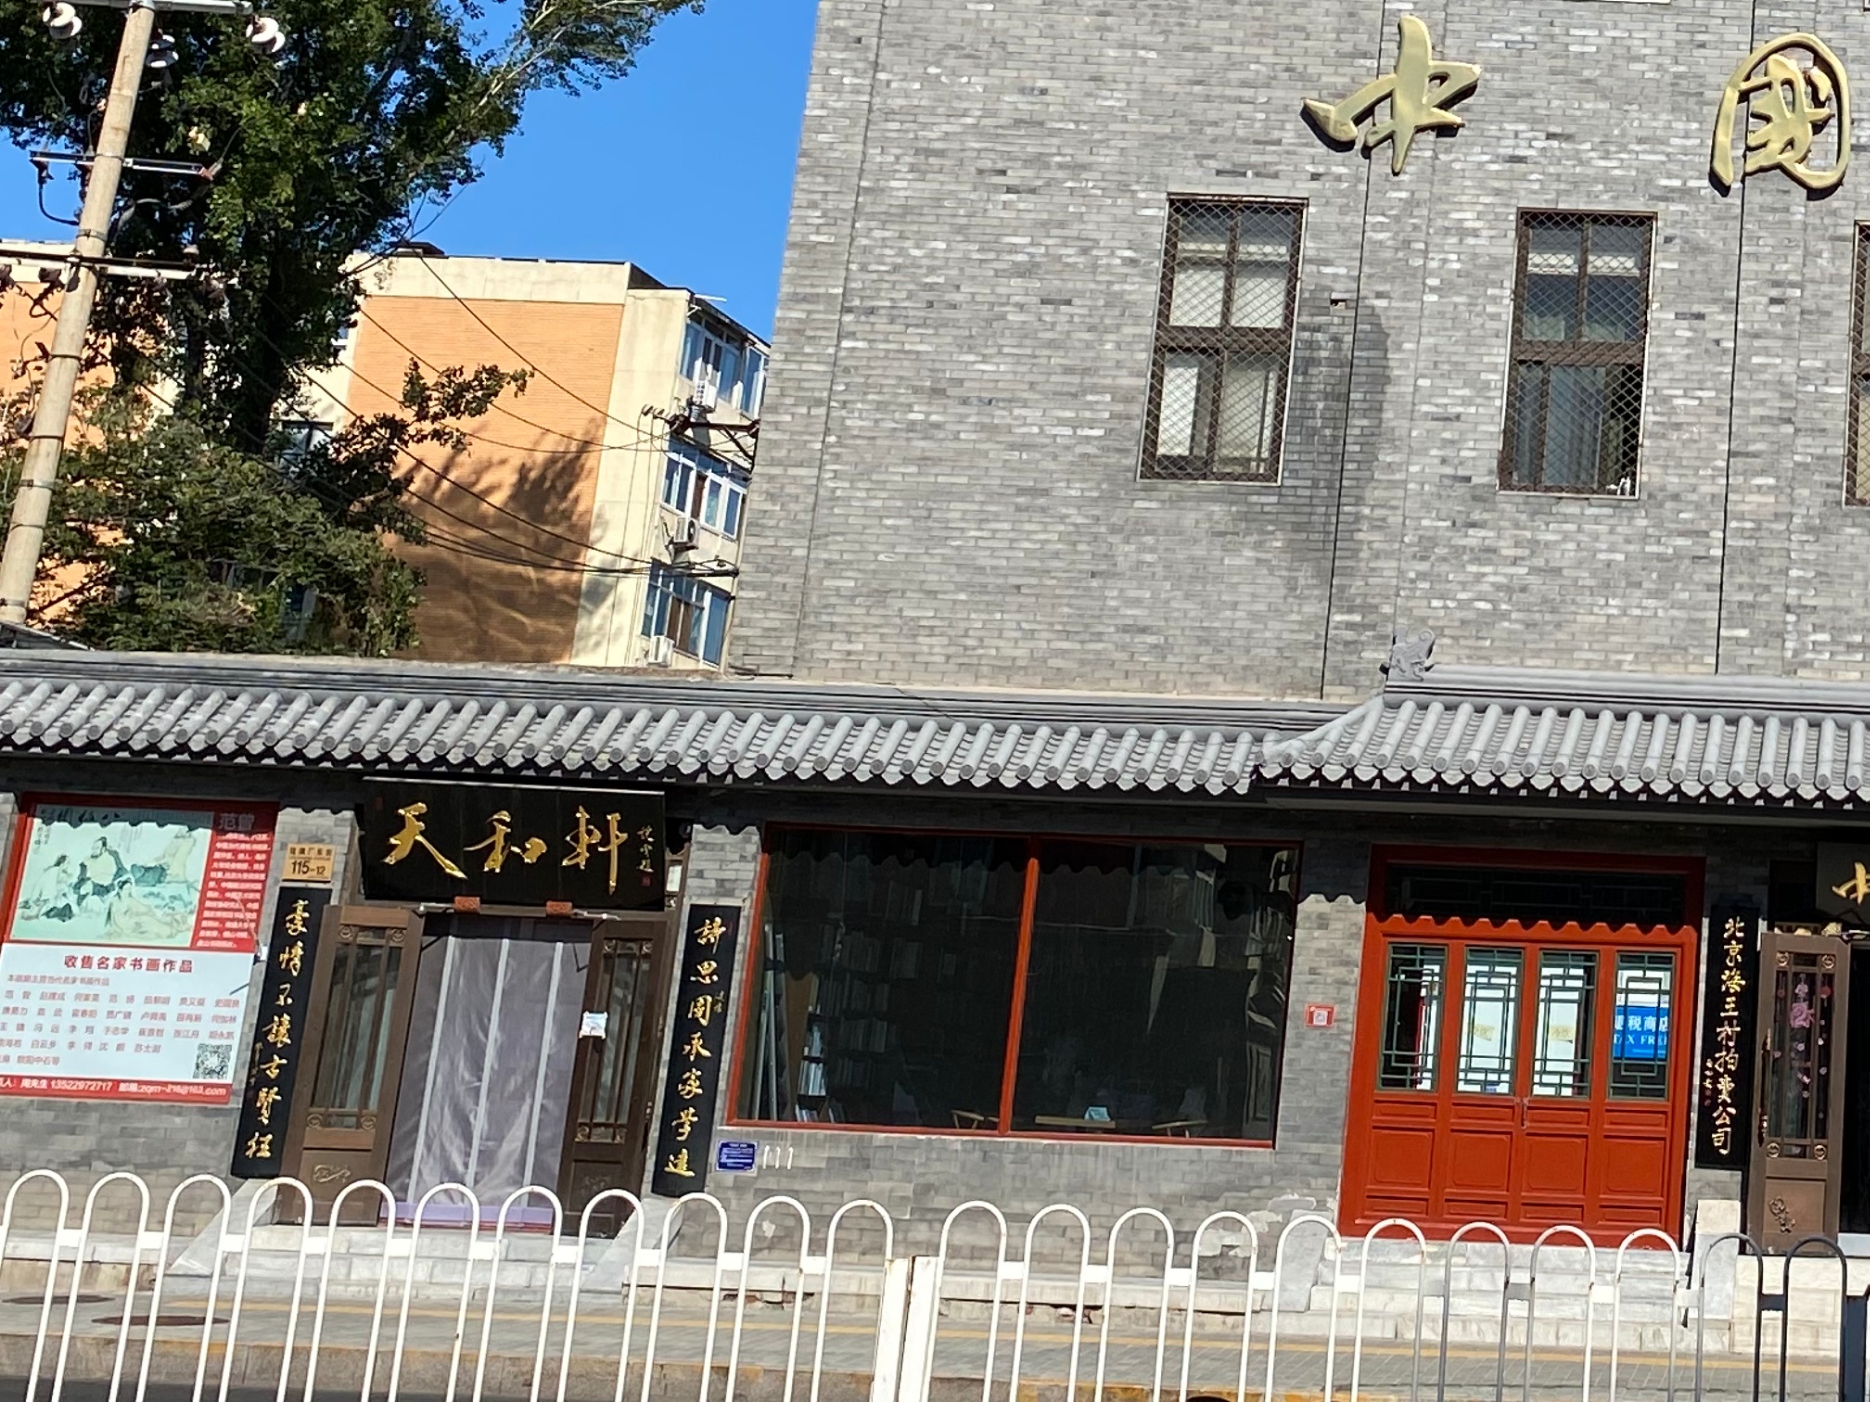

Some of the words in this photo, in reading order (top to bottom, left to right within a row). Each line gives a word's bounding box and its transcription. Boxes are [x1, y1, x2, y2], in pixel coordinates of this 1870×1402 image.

[291, 860, 326, 875] 115-12
[64, 955, 193, 973] 收售名家书画作品
